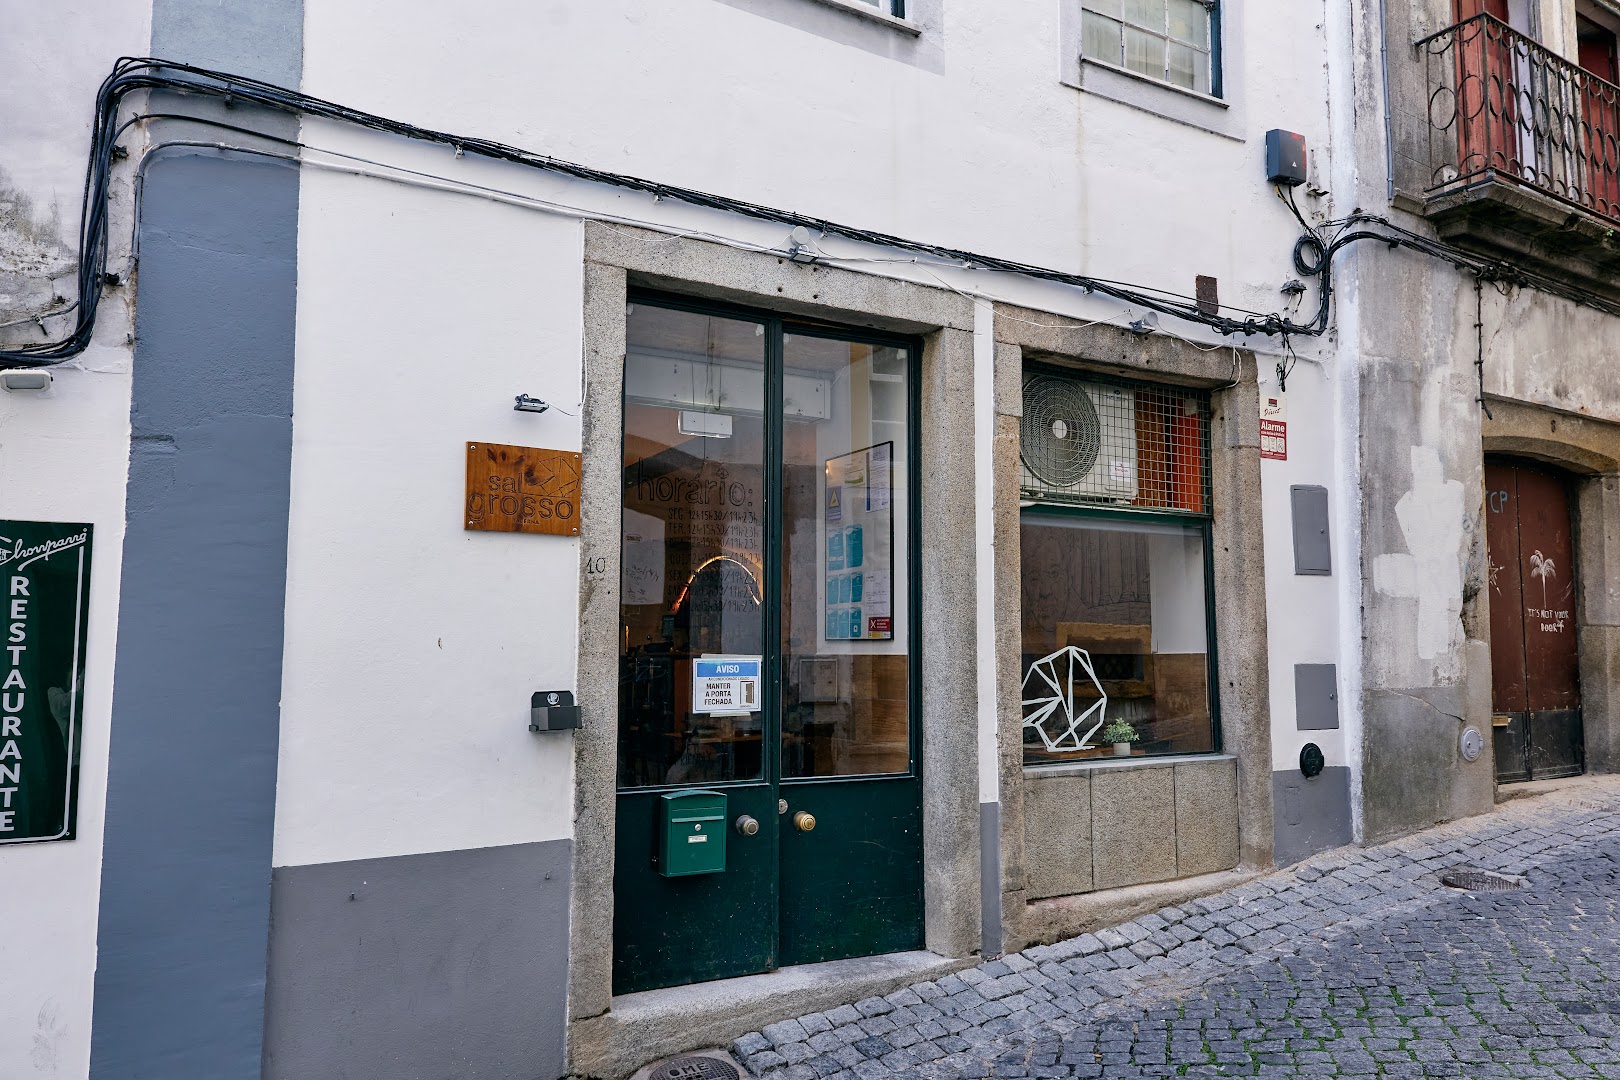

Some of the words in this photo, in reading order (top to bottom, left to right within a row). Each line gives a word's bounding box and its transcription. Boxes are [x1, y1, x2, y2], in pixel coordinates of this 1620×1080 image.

[1260, 421, 1285, 432] Alarme
[488, 472, 523, 493] sal
[637, 457, 753, 507] horário:
[467, 492, 574, 522] grosso
[1486, 490, 1508, 513] CP
[667, 508, 685, 521] SEG.
[586, 557, 606, 574] 10
[1540, 609, 1553, 619] NOT
[716, 665, 740, 673] AVISO
[0, 576, 30, 832] RESTAURANTE
